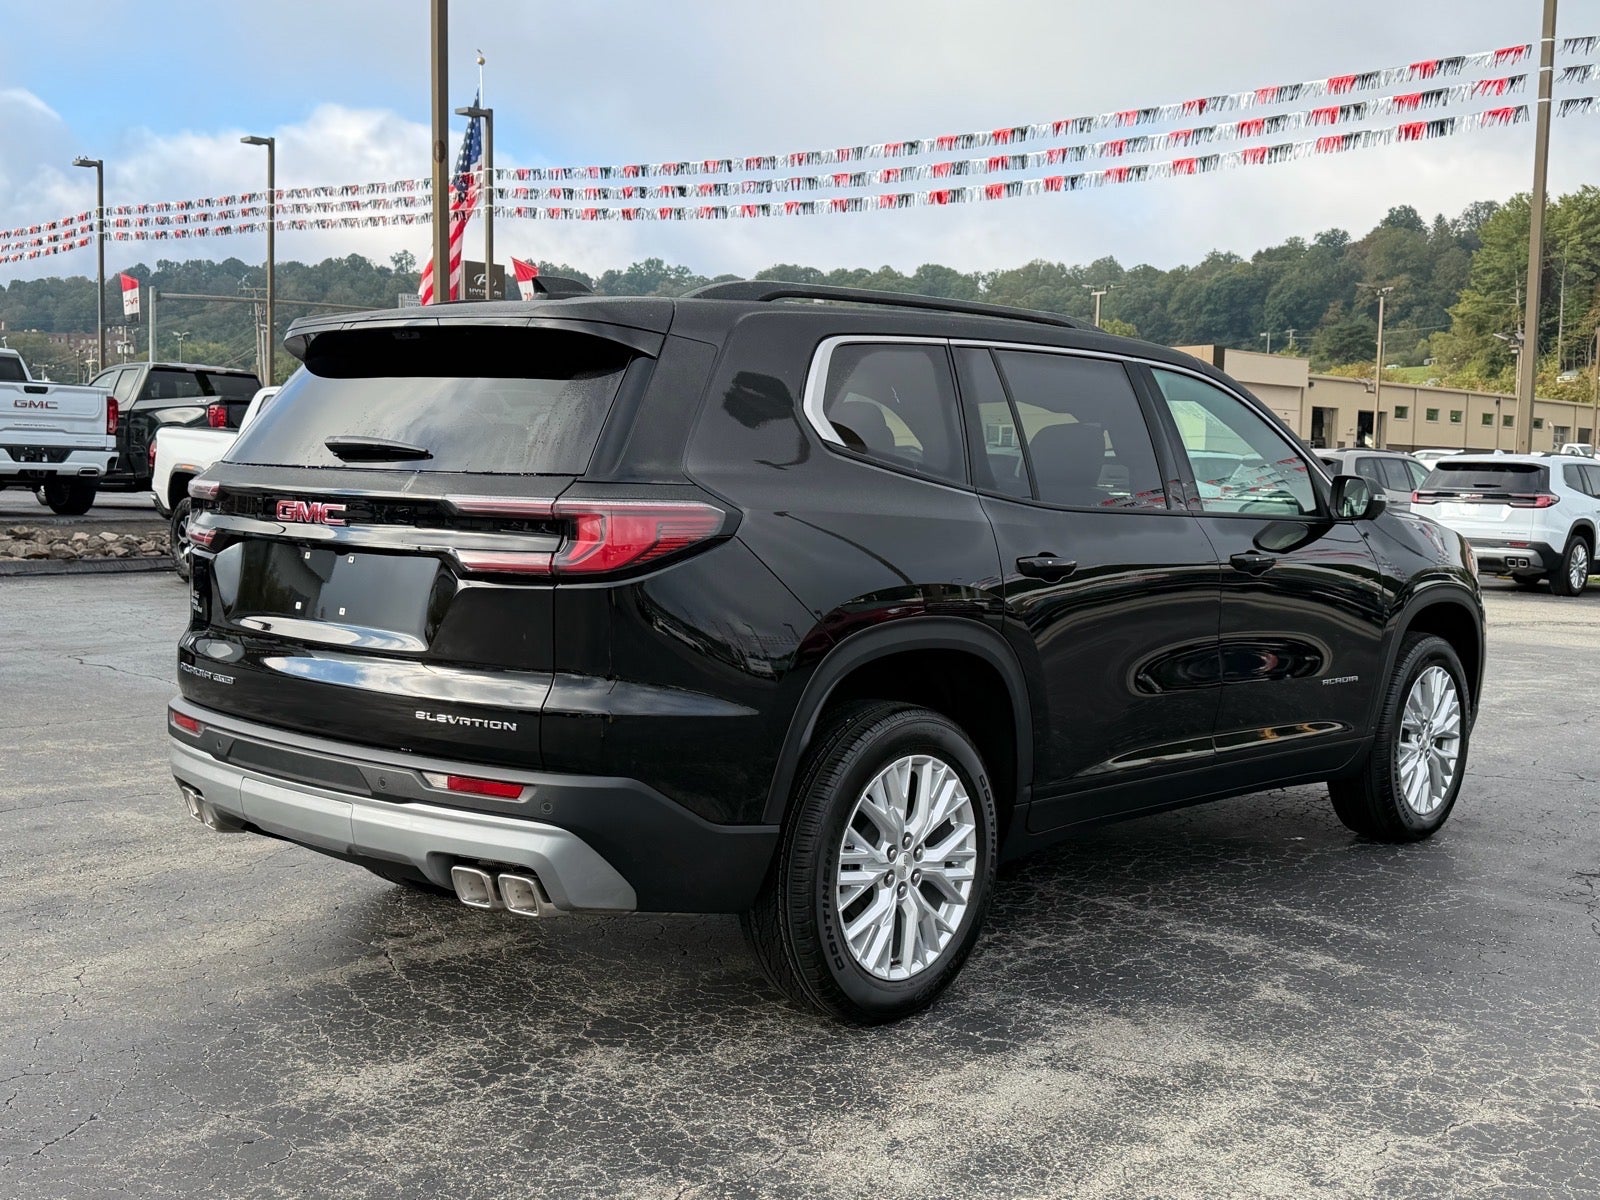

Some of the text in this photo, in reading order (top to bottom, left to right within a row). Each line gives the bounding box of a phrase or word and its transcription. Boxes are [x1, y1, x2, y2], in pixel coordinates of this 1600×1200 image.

[468, 287, 502, 295] HYUNAI
[14, 399, 59, 409] GMC
[276, 500, 347, 526] GMC
[1322, 675, 1359, 686] ACADIA
[415, 710, 518, 731] ELEVATION
